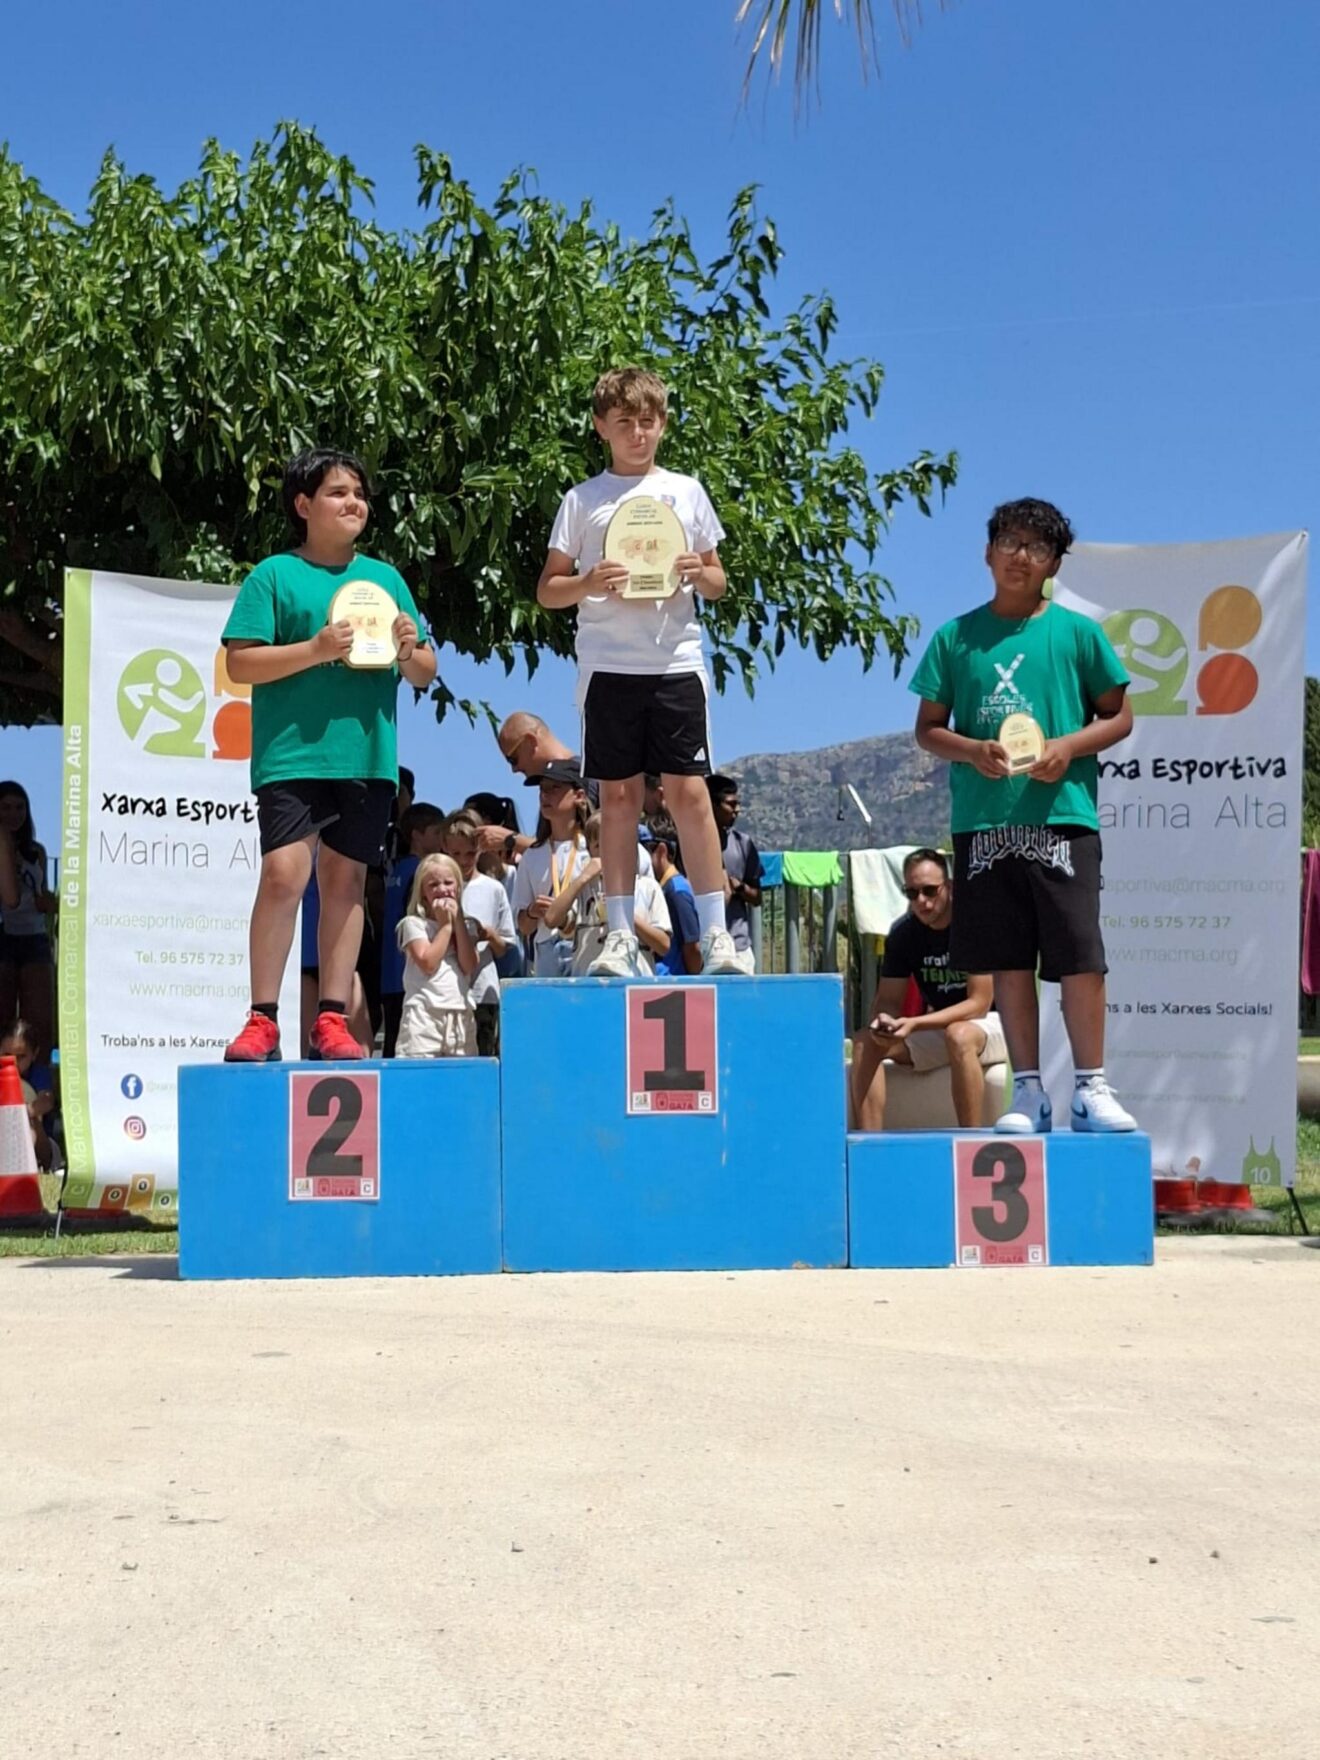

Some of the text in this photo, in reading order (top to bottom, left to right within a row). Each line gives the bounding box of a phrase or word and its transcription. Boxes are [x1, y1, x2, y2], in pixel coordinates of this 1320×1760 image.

[65, 724, 82, 768] Alta
[1097, 756, 1287, 785] rxa Esportiva
[65, 773, 82, 849] Marina
[176, 797, 256, 826] Esport
[1098, 793, 1287, 829] arina Alta
[99, 829, 257, 870] Marina Al
[64, 855, 80, 874] la
[63, 880, 80, 907] de
[92, 913, 249, 932] xarxaesportiva@macm
[1101, 915, 1232, 929] Tel. 96 575 72 37
[62, 913, 80, 1015] Comarcal
[135, 950, 245, 966] Tel. 96 575 72 37
[1106, 948, 1238, 966] ww.macma.org
[1123, 1002, 1132, 1014] a
[1136, 999, 1157, 1014] les
[1161, 1001, 1212, 1016] Xarxes
[1216, 1001, 1273, 1016] Socials!
[101, 1034, 155, 1048] Troba'ns
[158, 1038, 166, 1048] a
[169, 1034, 187, 1048] les
[643, 990, 706, 1091] 1
[306, 1076, 363, 1176] 2
[1250, 1166, 1271, 1184] 10
[971, 1141, 1030, 1243] 3
